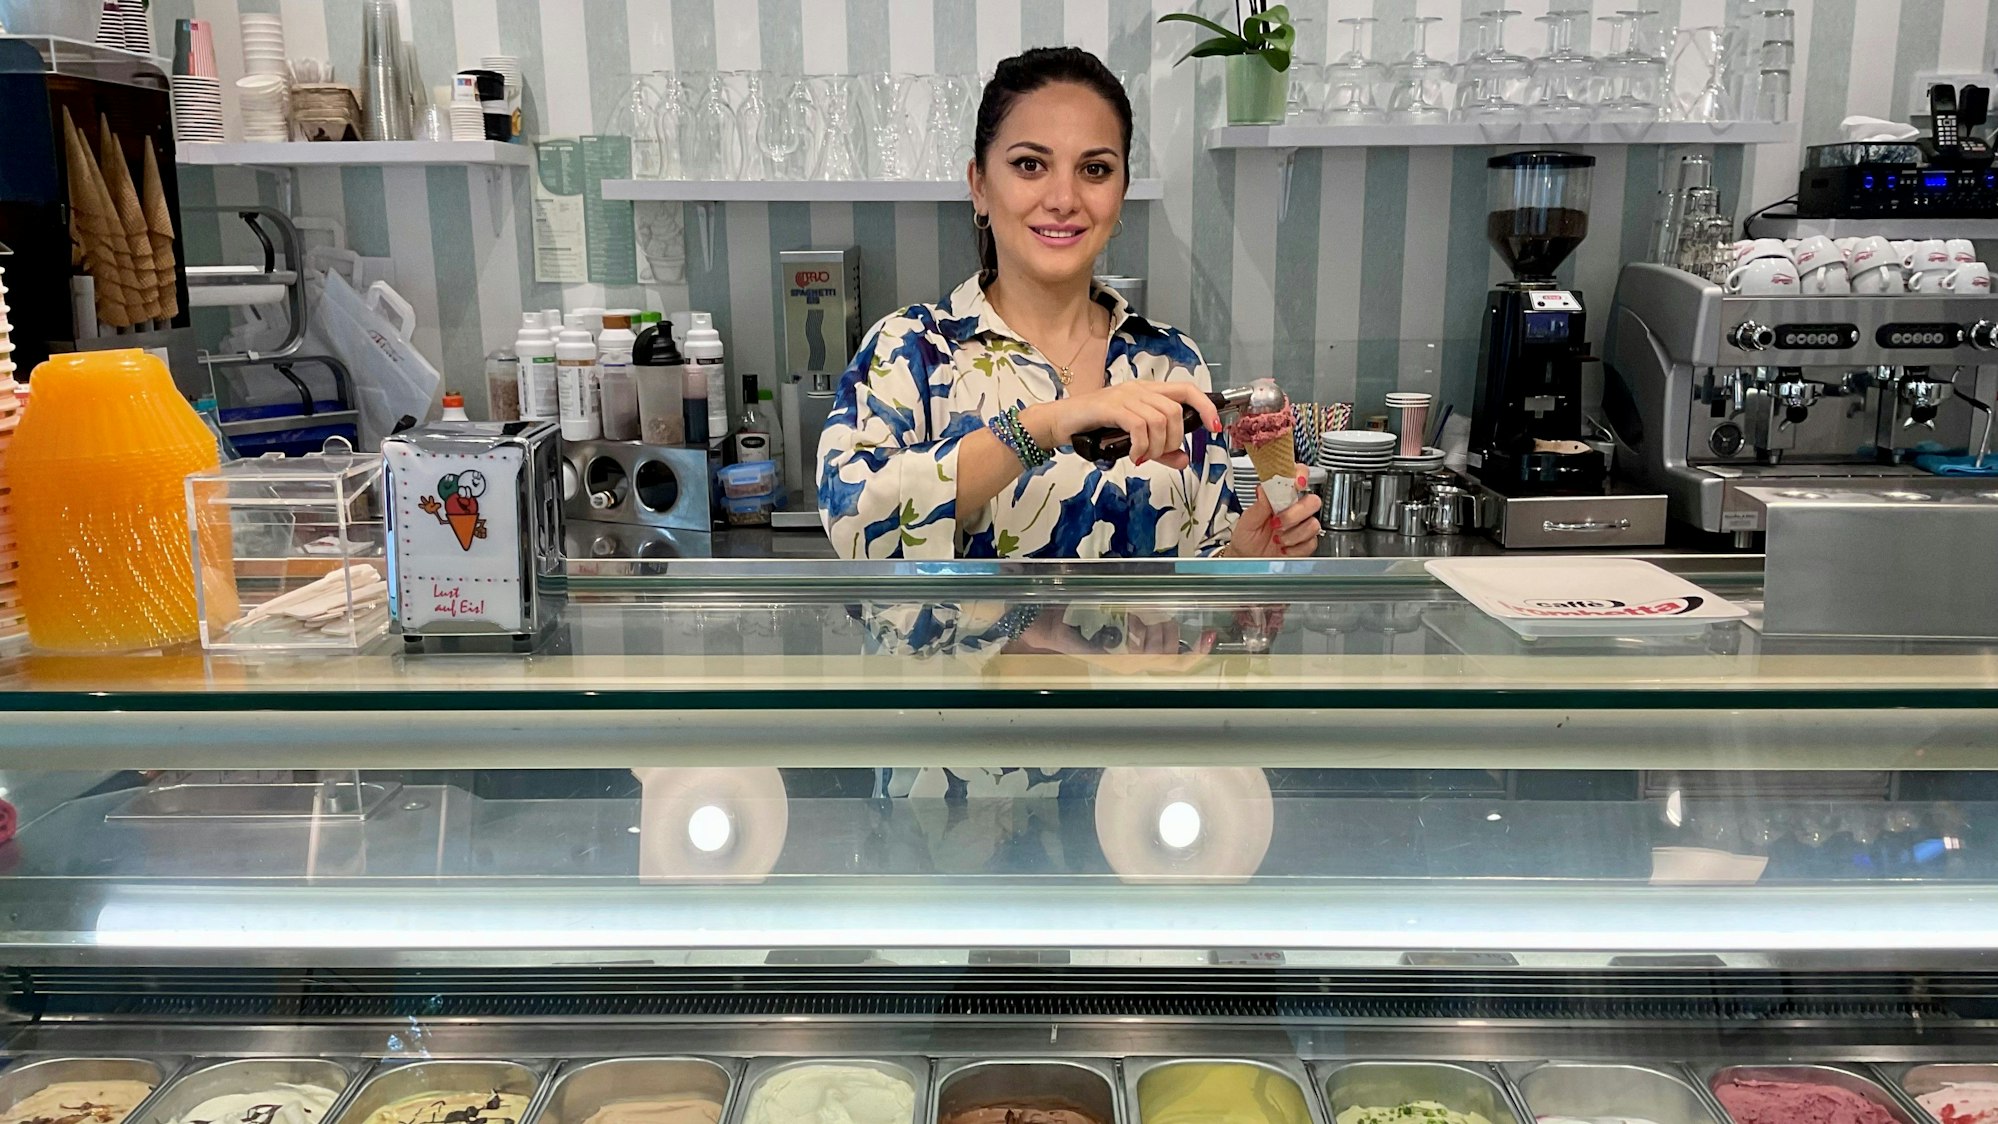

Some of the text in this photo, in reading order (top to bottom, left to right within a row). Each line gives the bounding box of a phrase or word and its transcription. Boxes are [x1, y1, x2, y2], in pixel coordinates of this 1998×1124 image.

[790, 288, 836, 297] SPAGHETTI
[434, 583, 459, 598] Lust
[434, 599, 484, 617] auf Eis!
